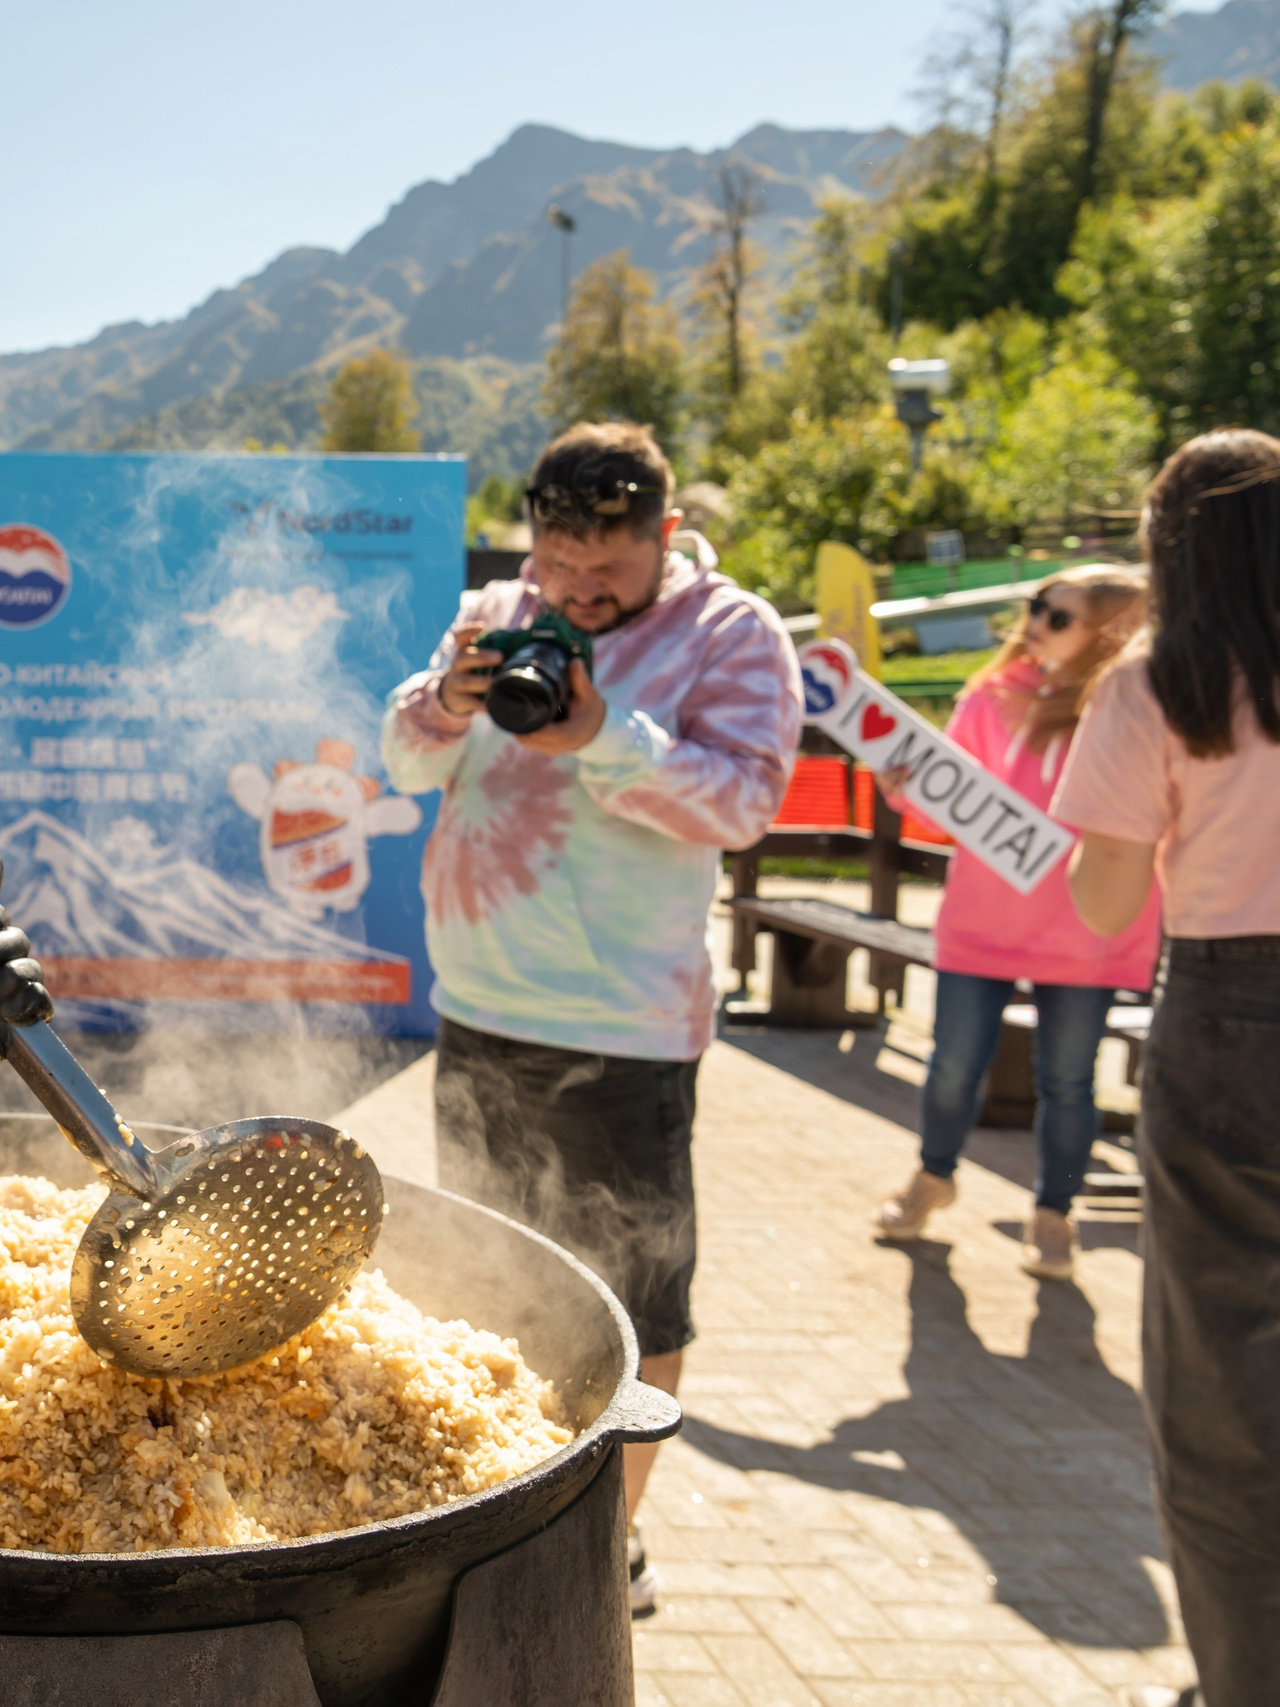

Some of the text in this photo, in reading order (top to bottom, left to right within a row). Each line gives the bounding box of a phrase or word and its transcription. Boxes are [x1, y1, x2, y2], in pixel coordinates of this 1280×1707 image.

[276, 507, 415, 535] NordStar
[838, 692, 1060, 880] I MOUTAI
